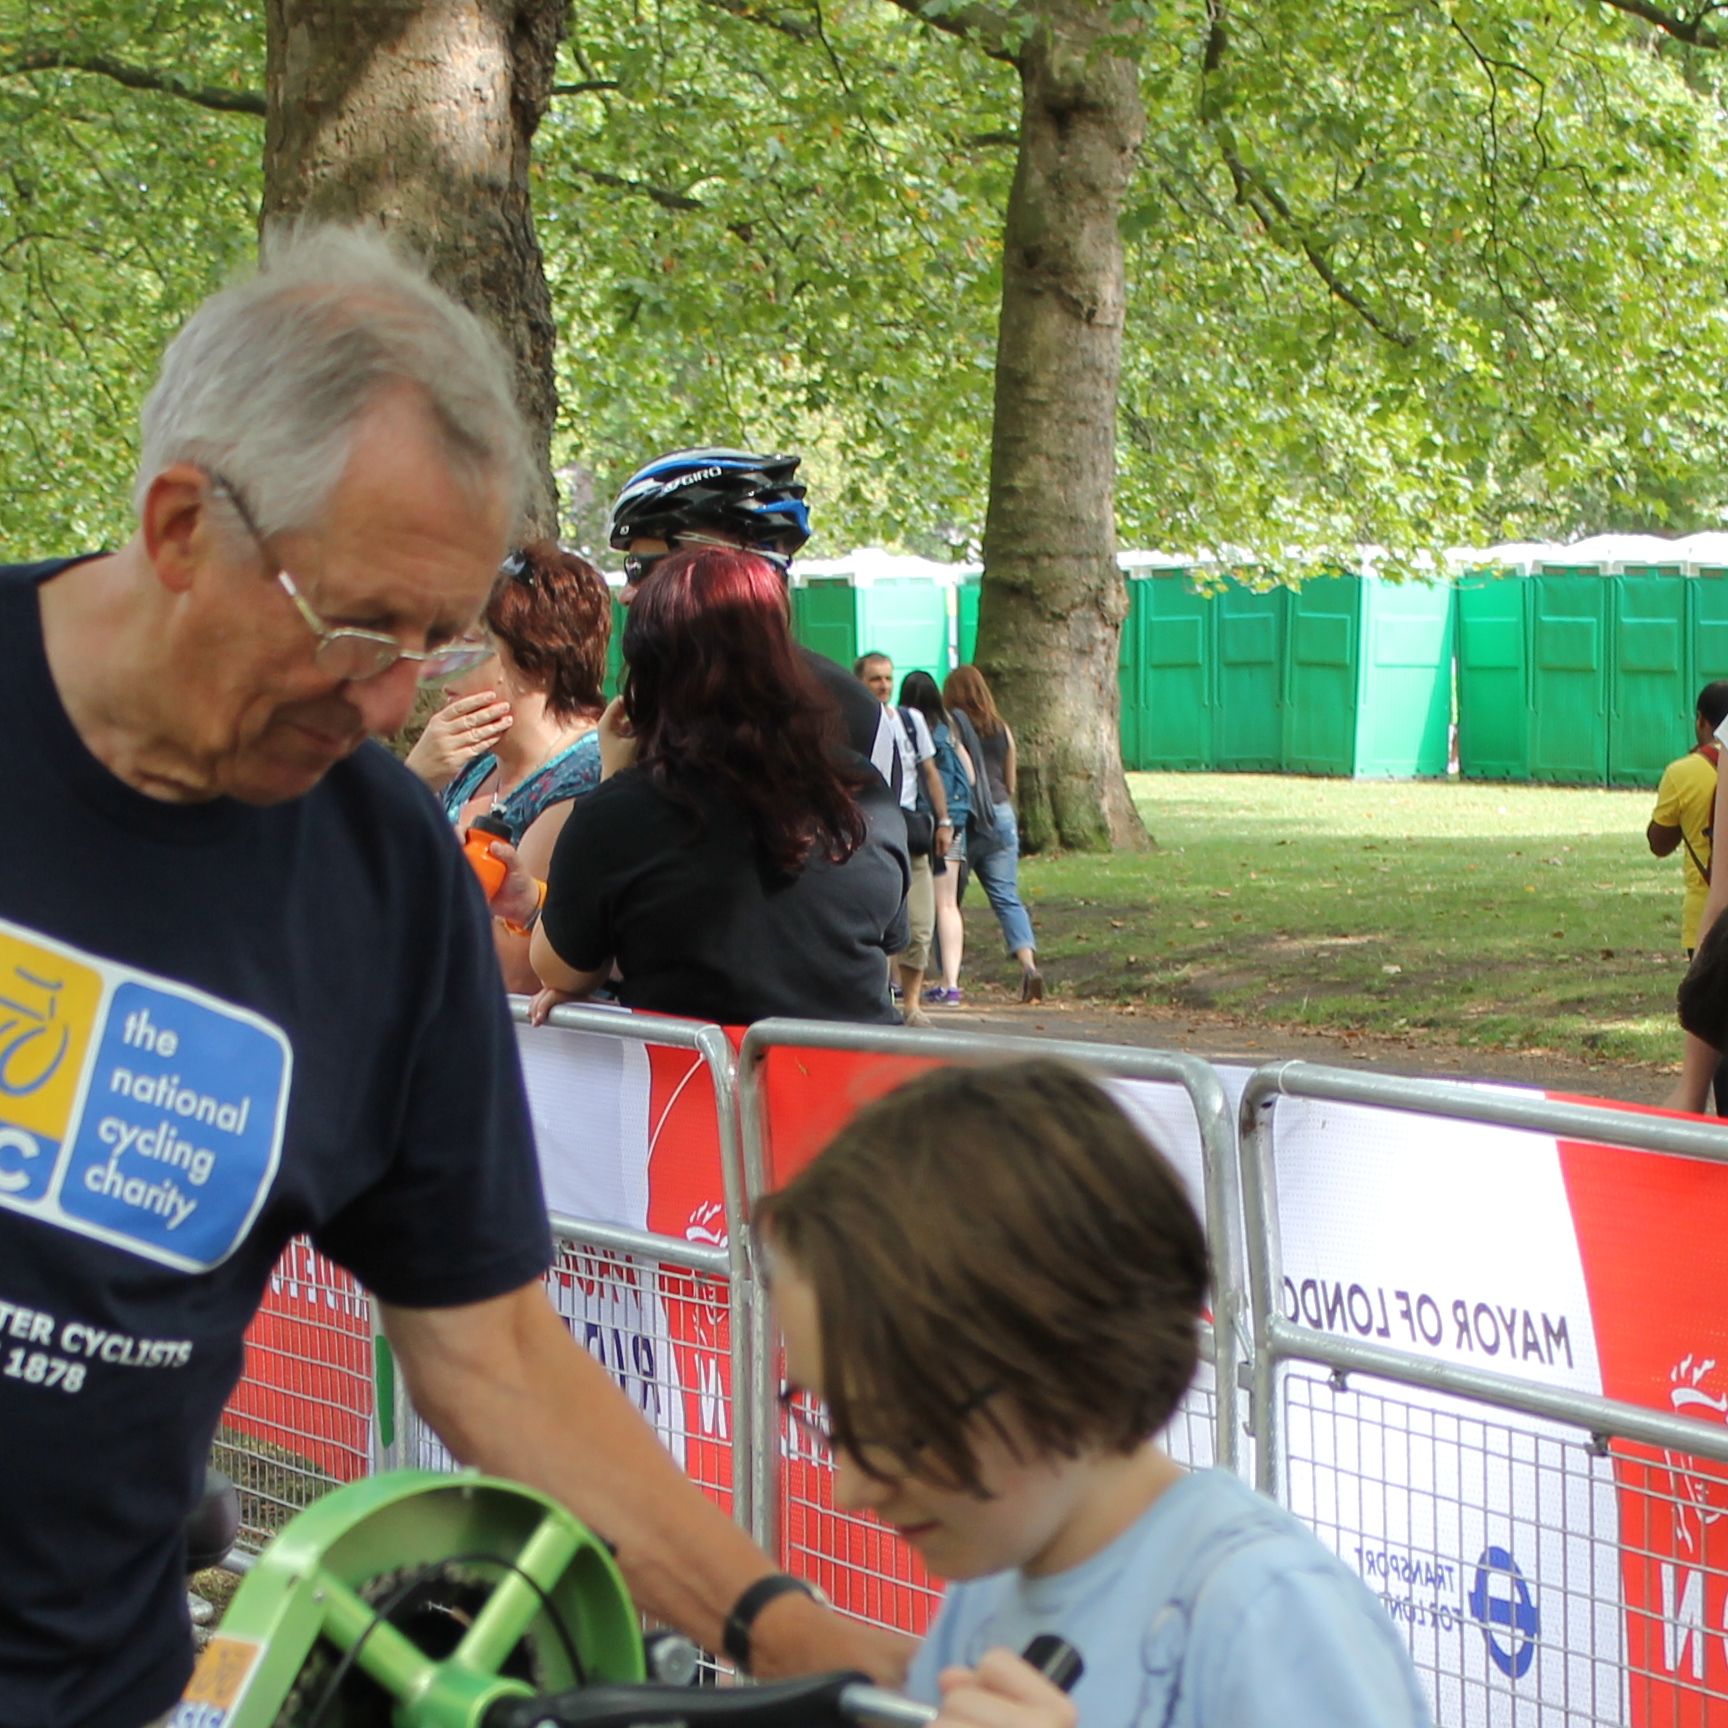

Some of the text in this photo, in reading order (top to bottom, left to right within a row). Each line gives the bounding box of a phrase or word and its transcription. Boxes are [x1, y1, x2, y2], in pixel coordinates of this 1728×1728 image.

[682, 465, 724, 486] GIRO
[123, 1007, 179, 1058] the
[110, 1067, 252, 1136] national
[97, 1116, 216, 1187] cycling
[84, 1157, 198, 1230] charity
[3, 1348, 87, 1394] 1878
[60, 1322, 194, 1369] CYCLISTS
